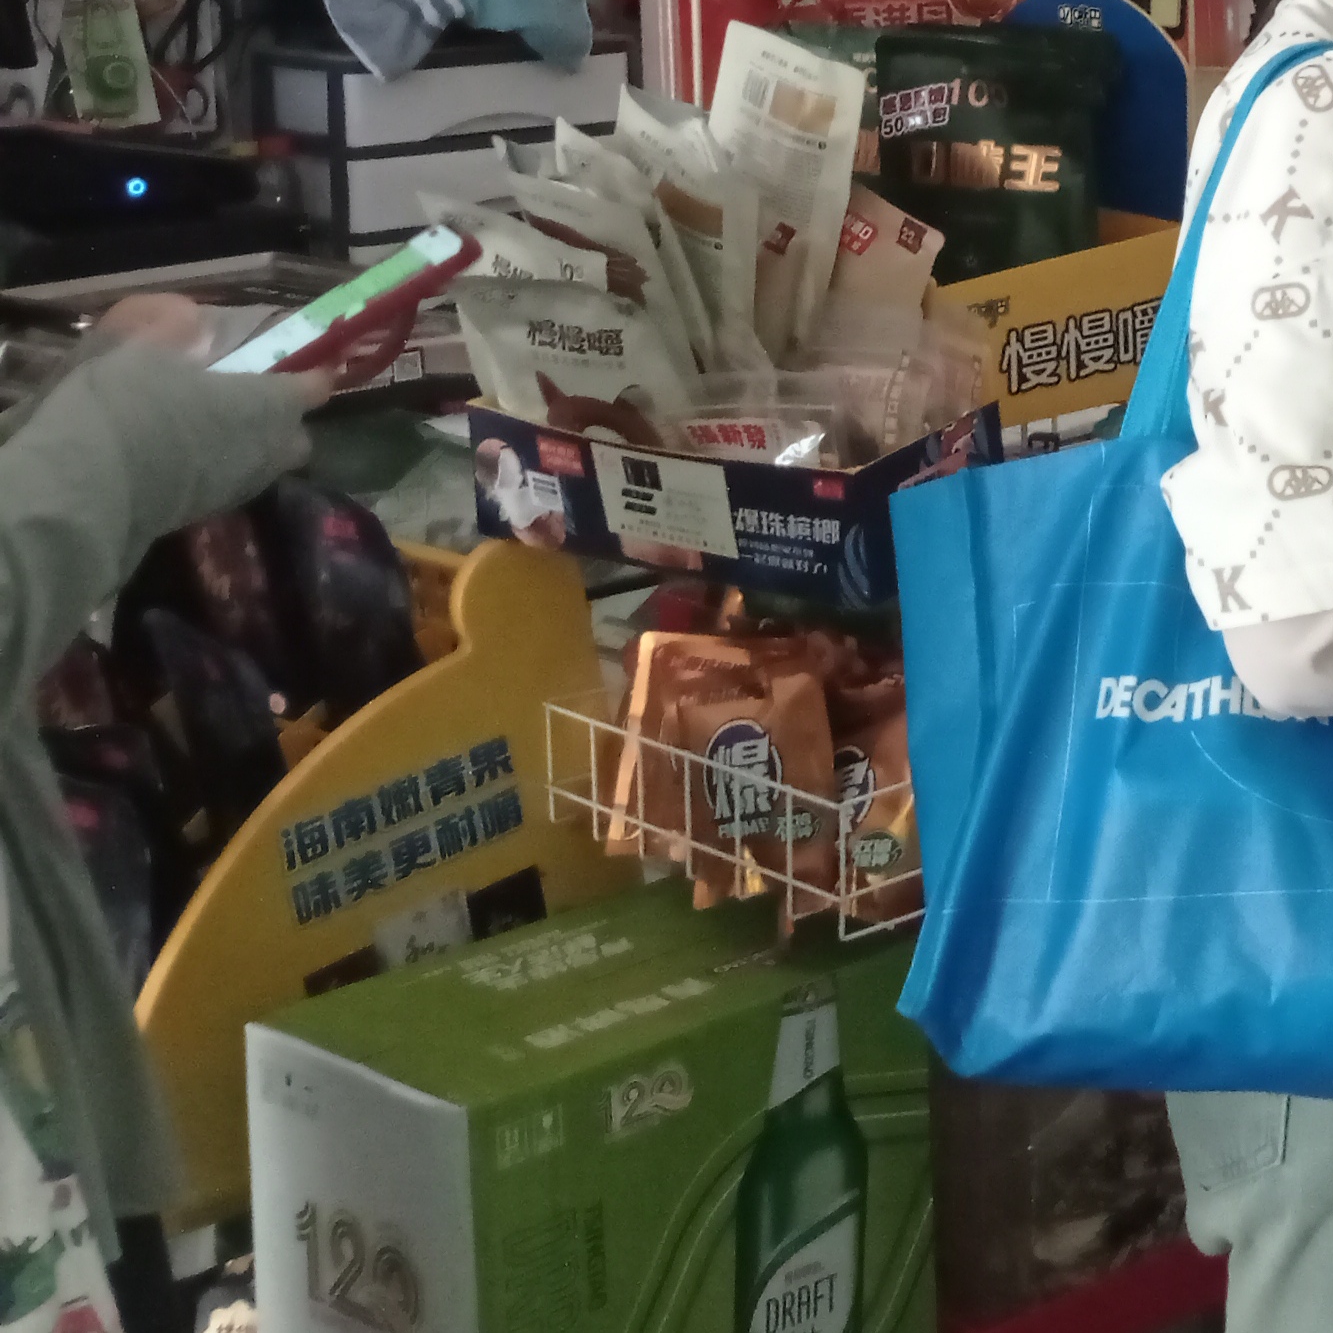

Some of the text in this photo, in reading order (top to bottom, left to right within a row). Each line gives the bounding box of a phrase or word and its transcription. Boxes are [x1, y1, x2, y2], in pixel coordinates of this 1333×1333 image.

[1212, 564, 1252, 613] K
[279, 735, 516, 870] 海南嫩青果
[290, 792, 525, 927] 味美更耐嚼
[765, 1272, 838, 1333] DRAFT
